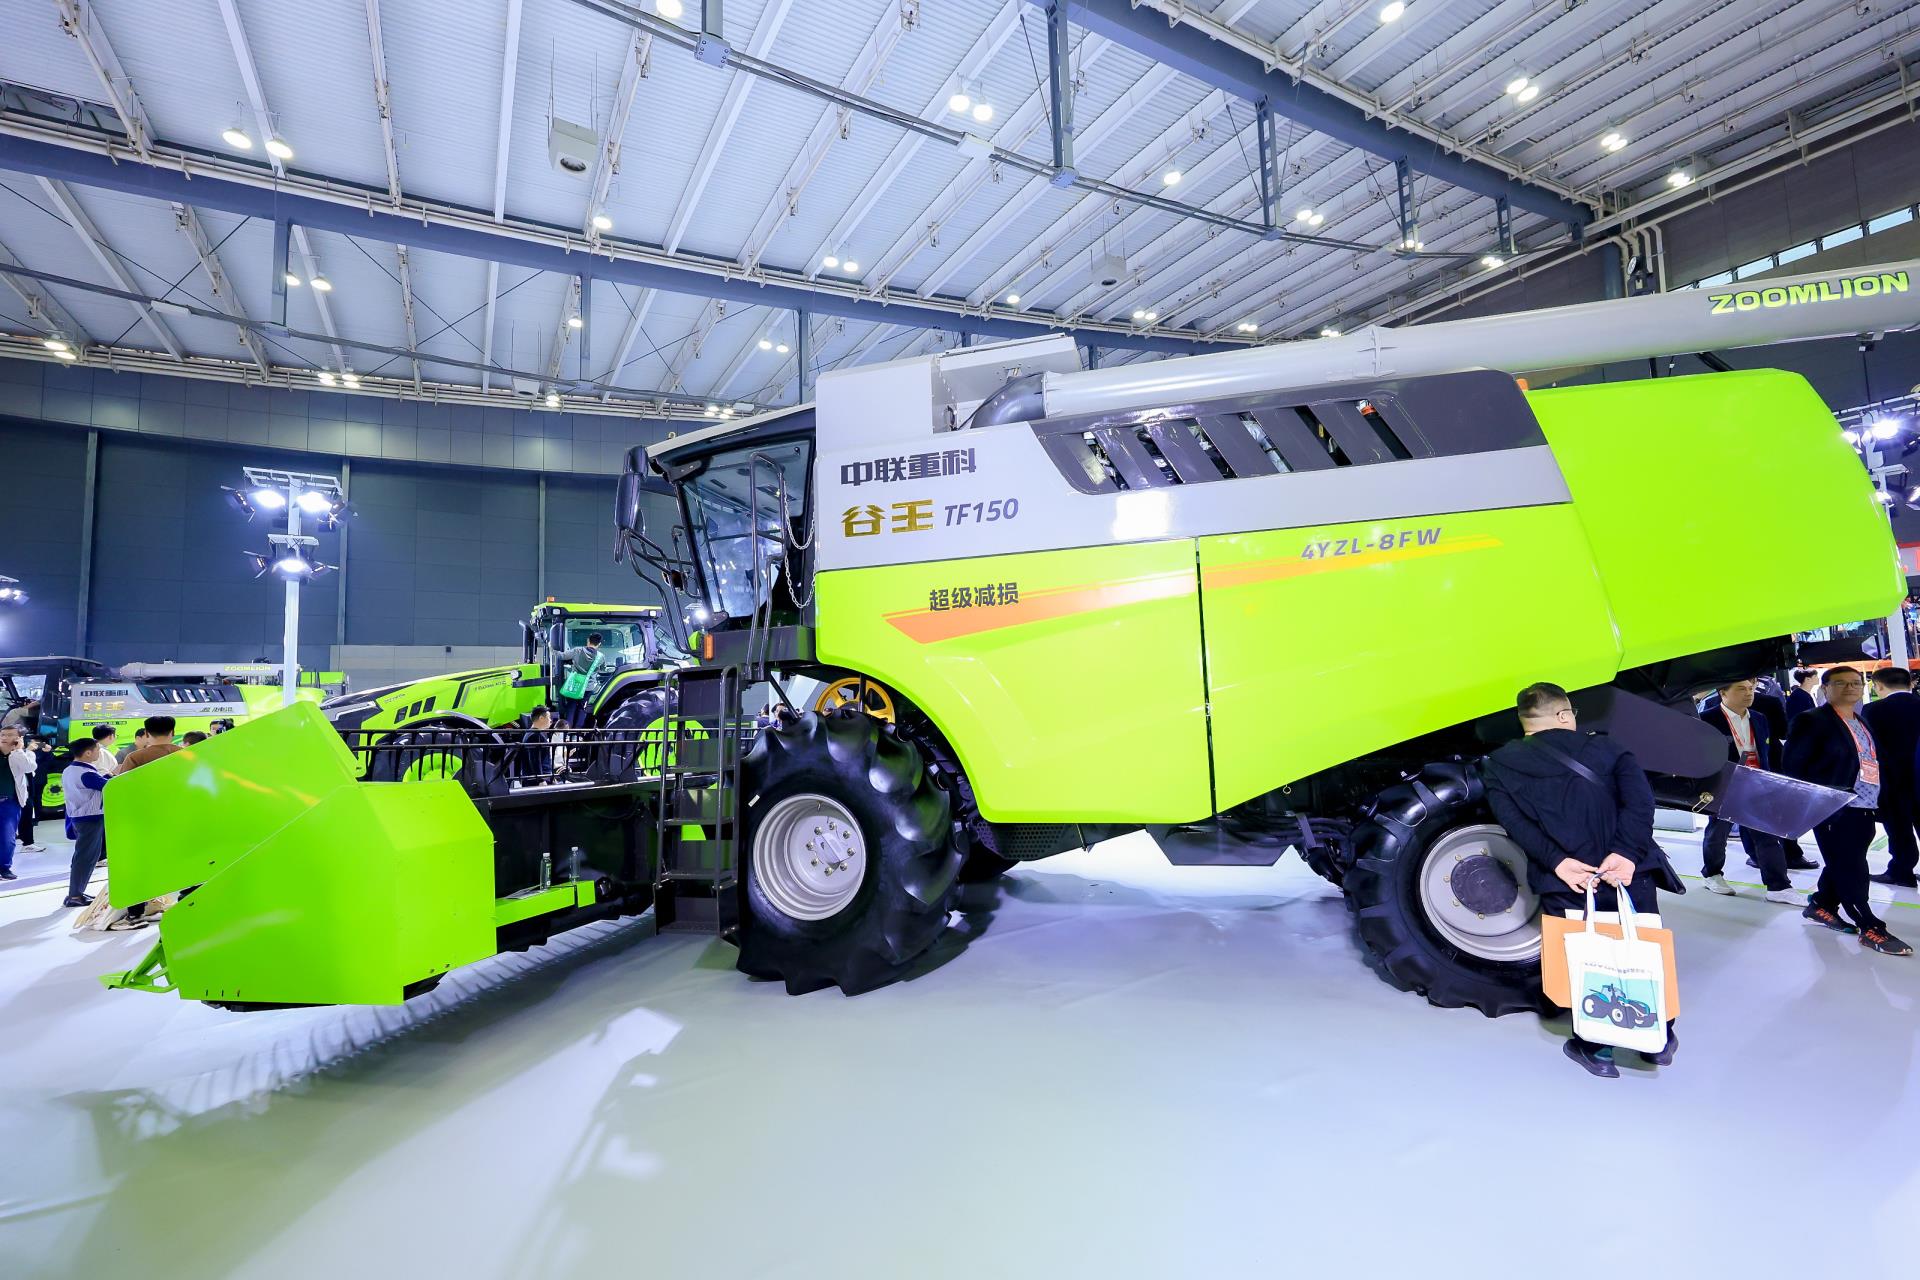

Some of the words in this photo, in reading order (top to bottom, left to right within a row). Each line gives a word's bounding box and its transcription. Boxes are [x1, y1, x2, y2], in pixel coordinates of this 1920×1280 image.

[1707, 271, 1910, 315] ZOOMLION
[840, 448, 977, 486] 中联重科
[841, 499, 934, 537] 谷王
[944, 498, 1019, 527] TF150
[1301, 527, 1442, 560] 4YZL-8FW
[929, 582, 1019, 611] 超级减损
